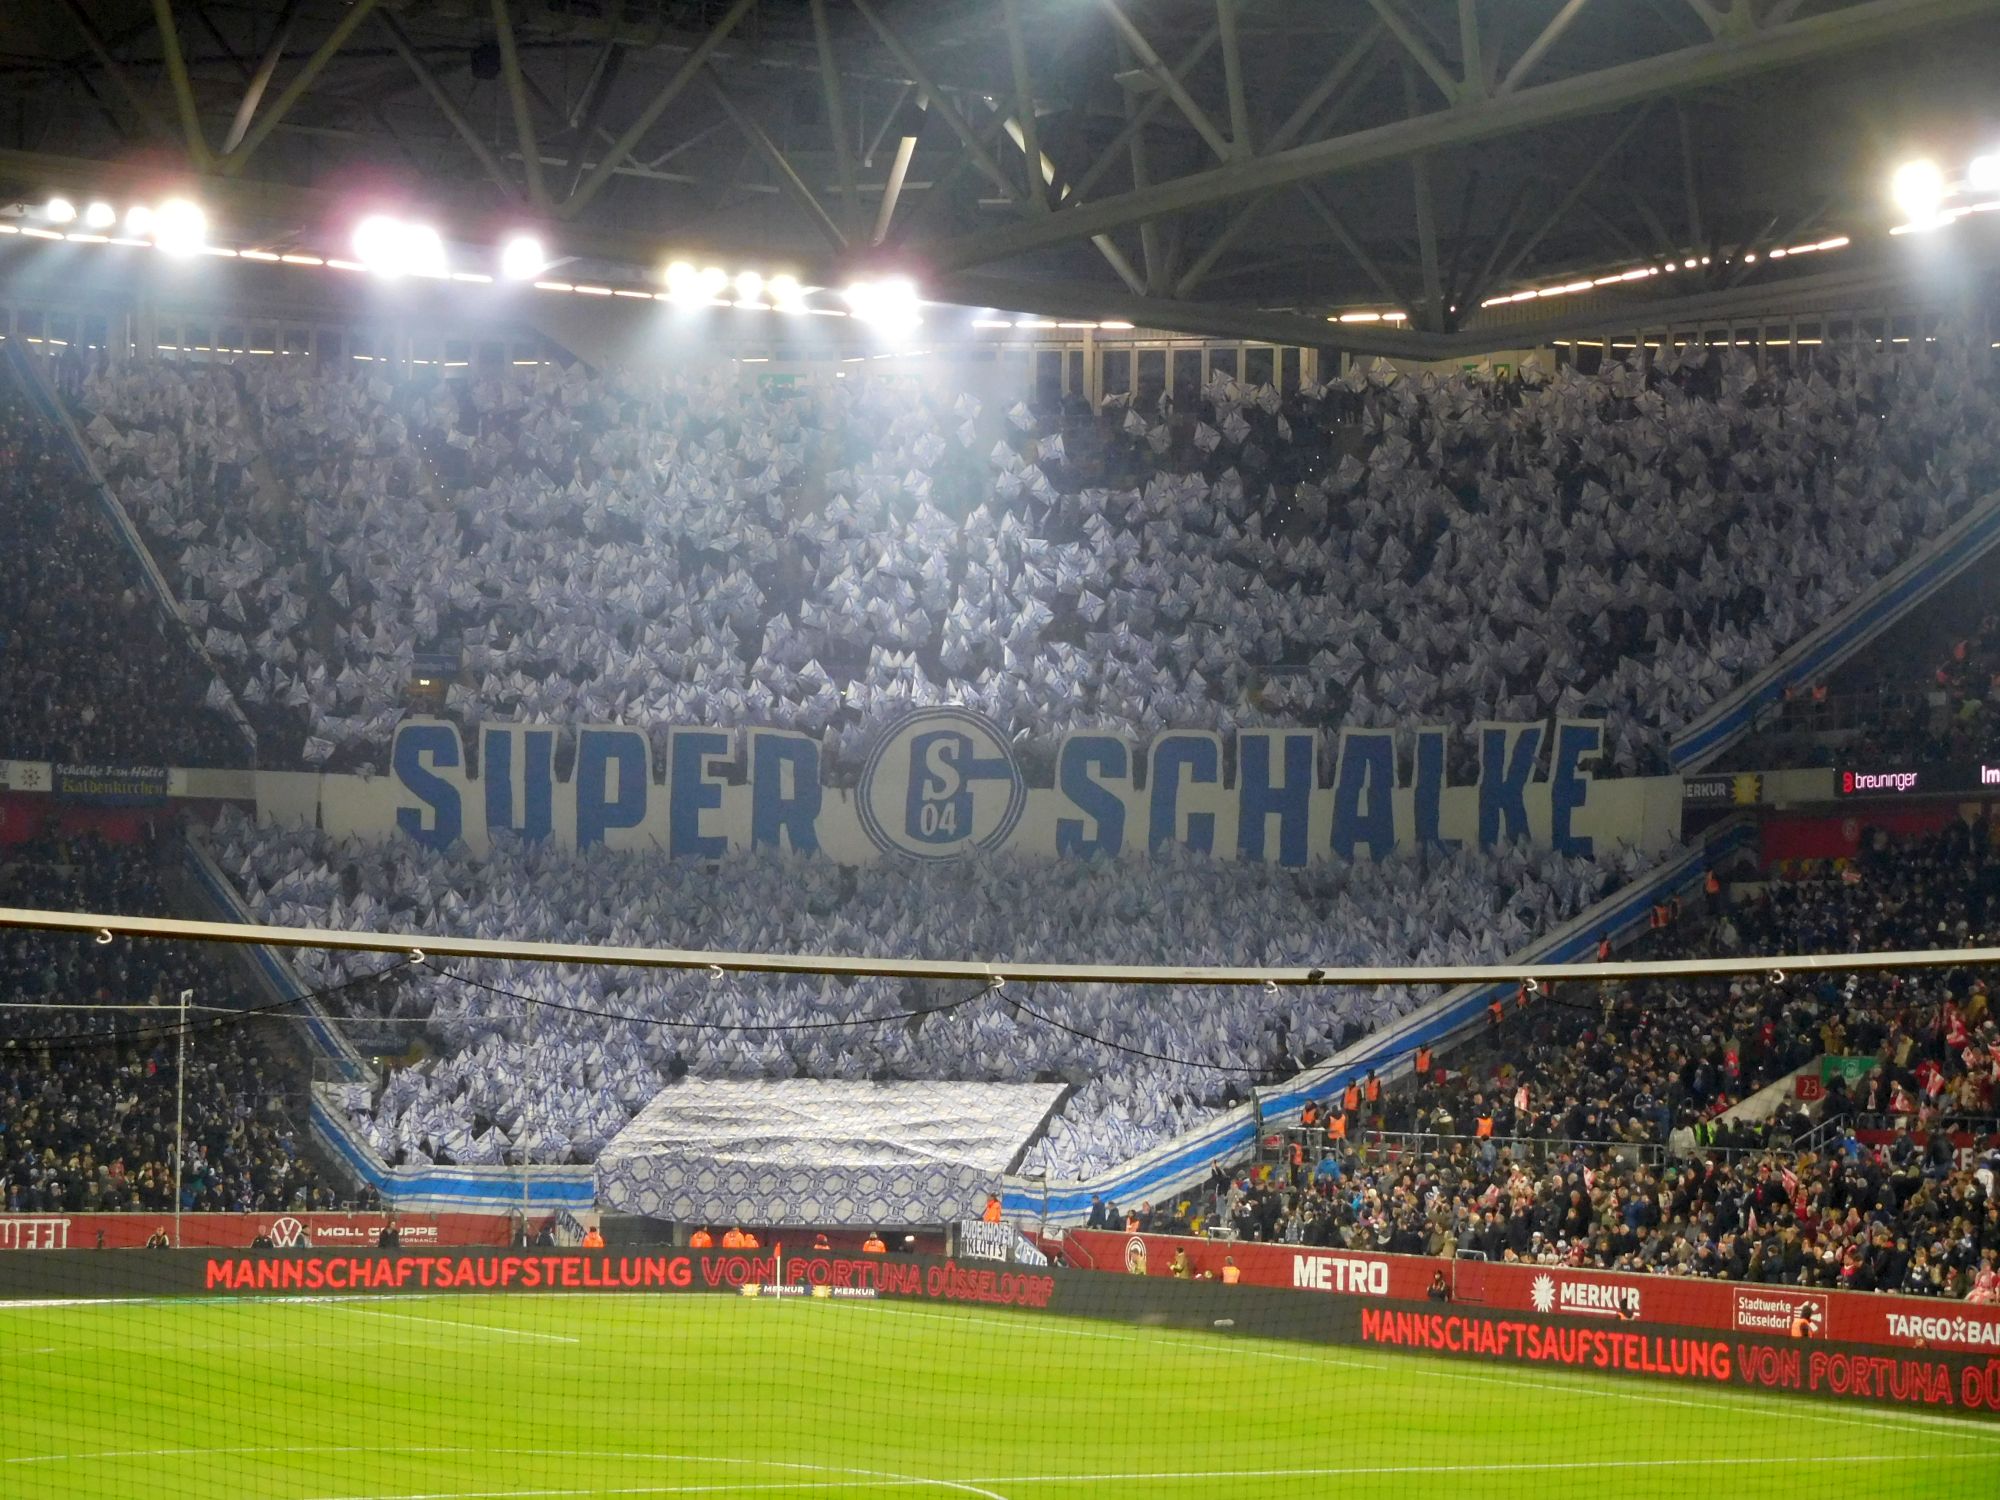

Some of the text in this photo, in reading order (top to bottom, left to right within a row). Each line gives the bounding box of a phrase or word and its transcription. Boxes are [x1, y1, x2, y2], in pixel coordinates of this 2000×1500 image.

[1855, 772, 1918, 791] breuninger
[396, 724, 1601, 867] SUPER SCHALKE
[1802, 1080, 1818, 1096] 23
[317, 1227, 364, 1236] MOLL
[205, 1256, 692, 1290] MANNSCHAFTSAUFSTELLUNG
[702, 1256, 776, 1288] VON
[785, 1260, 921, 1297] FORTUNA
[1293, 1255, 1388, 1294] METRO
[764, 1285, 804, 1294] MERKUR
[834, 1287, 875, 1296] MERKUR
[1561, 1282, 1640, 1309] MERKUR
[1738, 1296, 1791, 1313] Stadtwerke
[1738, 1311, 1791, 1329] Düsseldorf
[1361, 1308, 1730, 1380] MANNSCHAFTSAUFSTELLUNG
[1737, 1344, 1801, 1388] VON
[1809, 1351, 1954, 1405] FORTUNA
